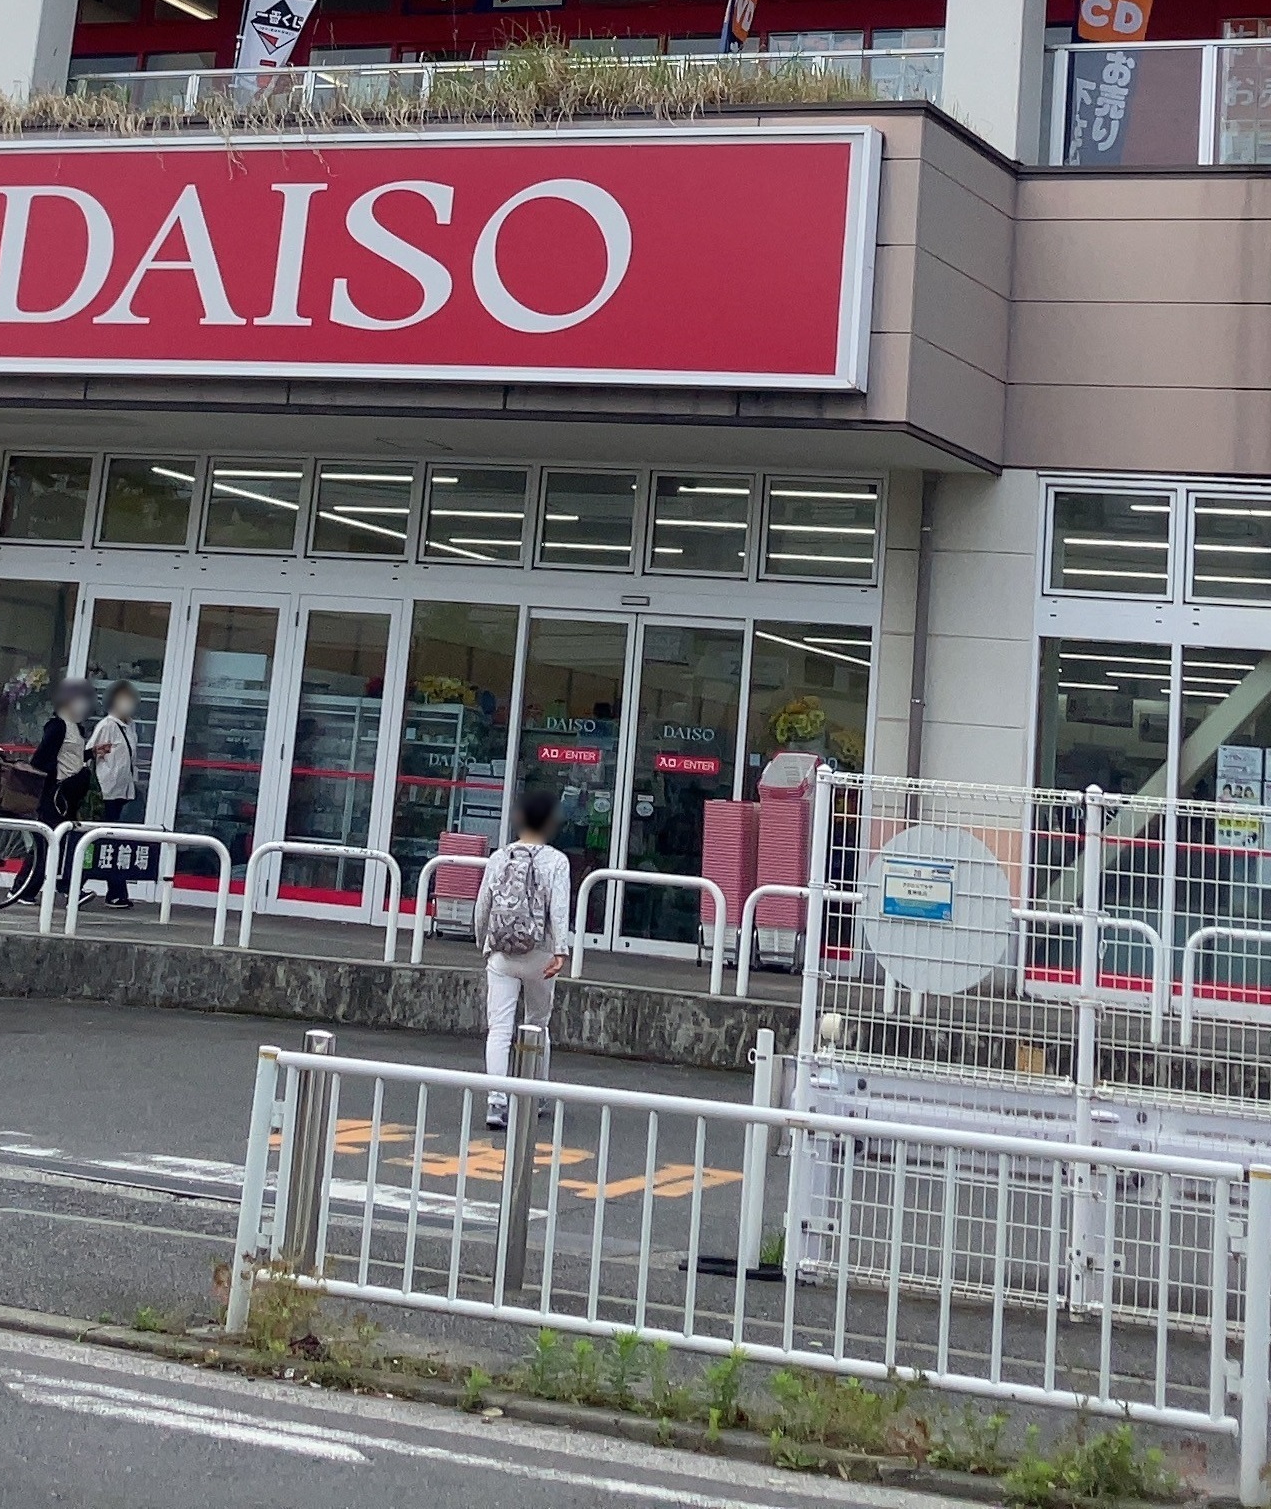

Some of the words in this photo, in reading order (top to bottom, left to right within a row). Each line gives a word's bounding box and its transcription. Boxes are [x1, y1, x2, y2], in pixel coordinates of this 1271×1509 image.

[1092, 51, 1137, 152] お売り
[546, 716, 597, 734] DAISO
[663, 724, 715, 742] DAISO
[97, 842, 150, 871] 駐輪場
